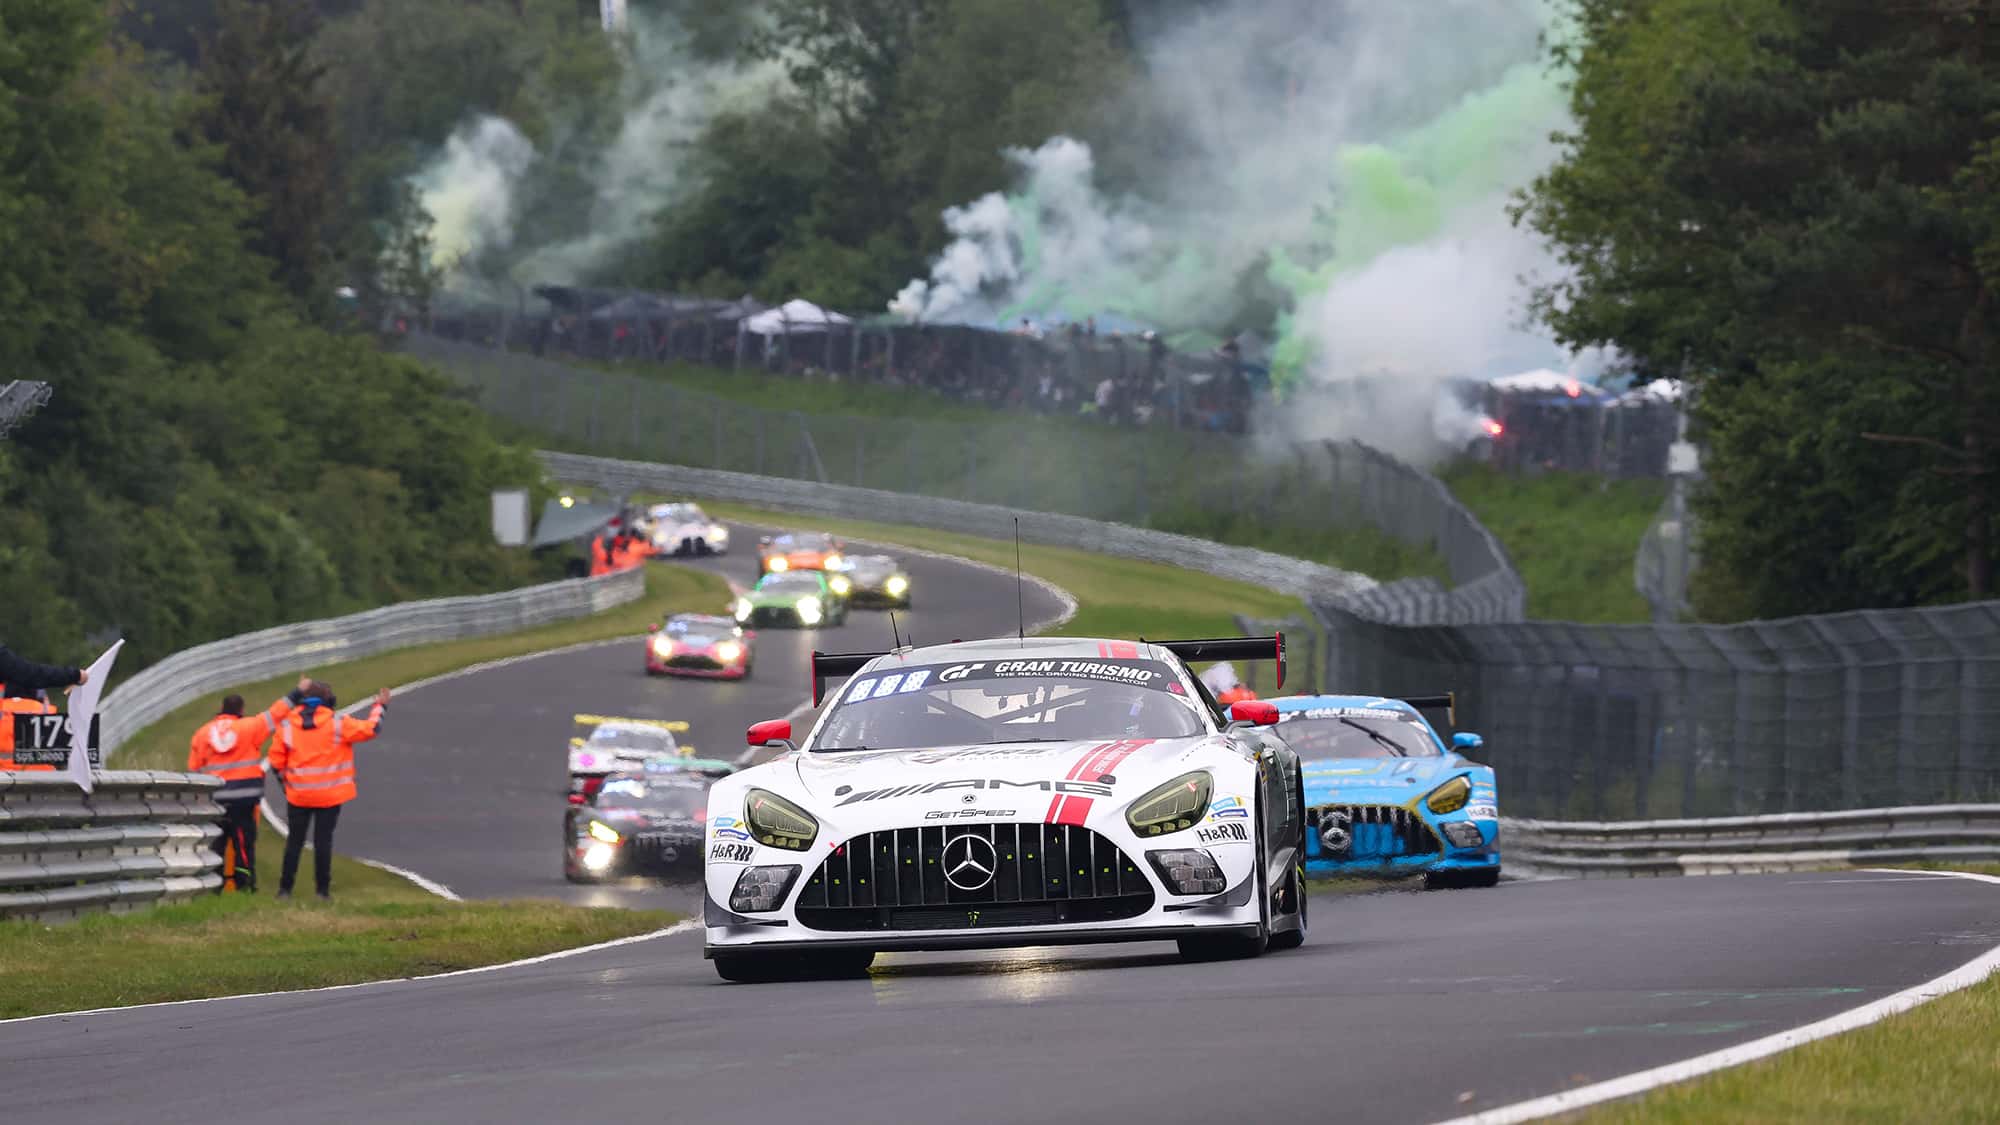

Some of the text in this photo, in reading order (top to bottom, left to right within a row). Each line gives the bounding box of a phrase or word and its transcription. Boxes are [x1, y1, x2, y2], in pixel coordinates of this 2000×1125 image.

[995, 661, 1056, 673] GRAN
[1090, 674, 1148, 687] SIMULATOR
[924, 778, 1113, 798] AMG
[1196, 824, 1232, 843] H&R
[711, 843, 736, 859] H&R
